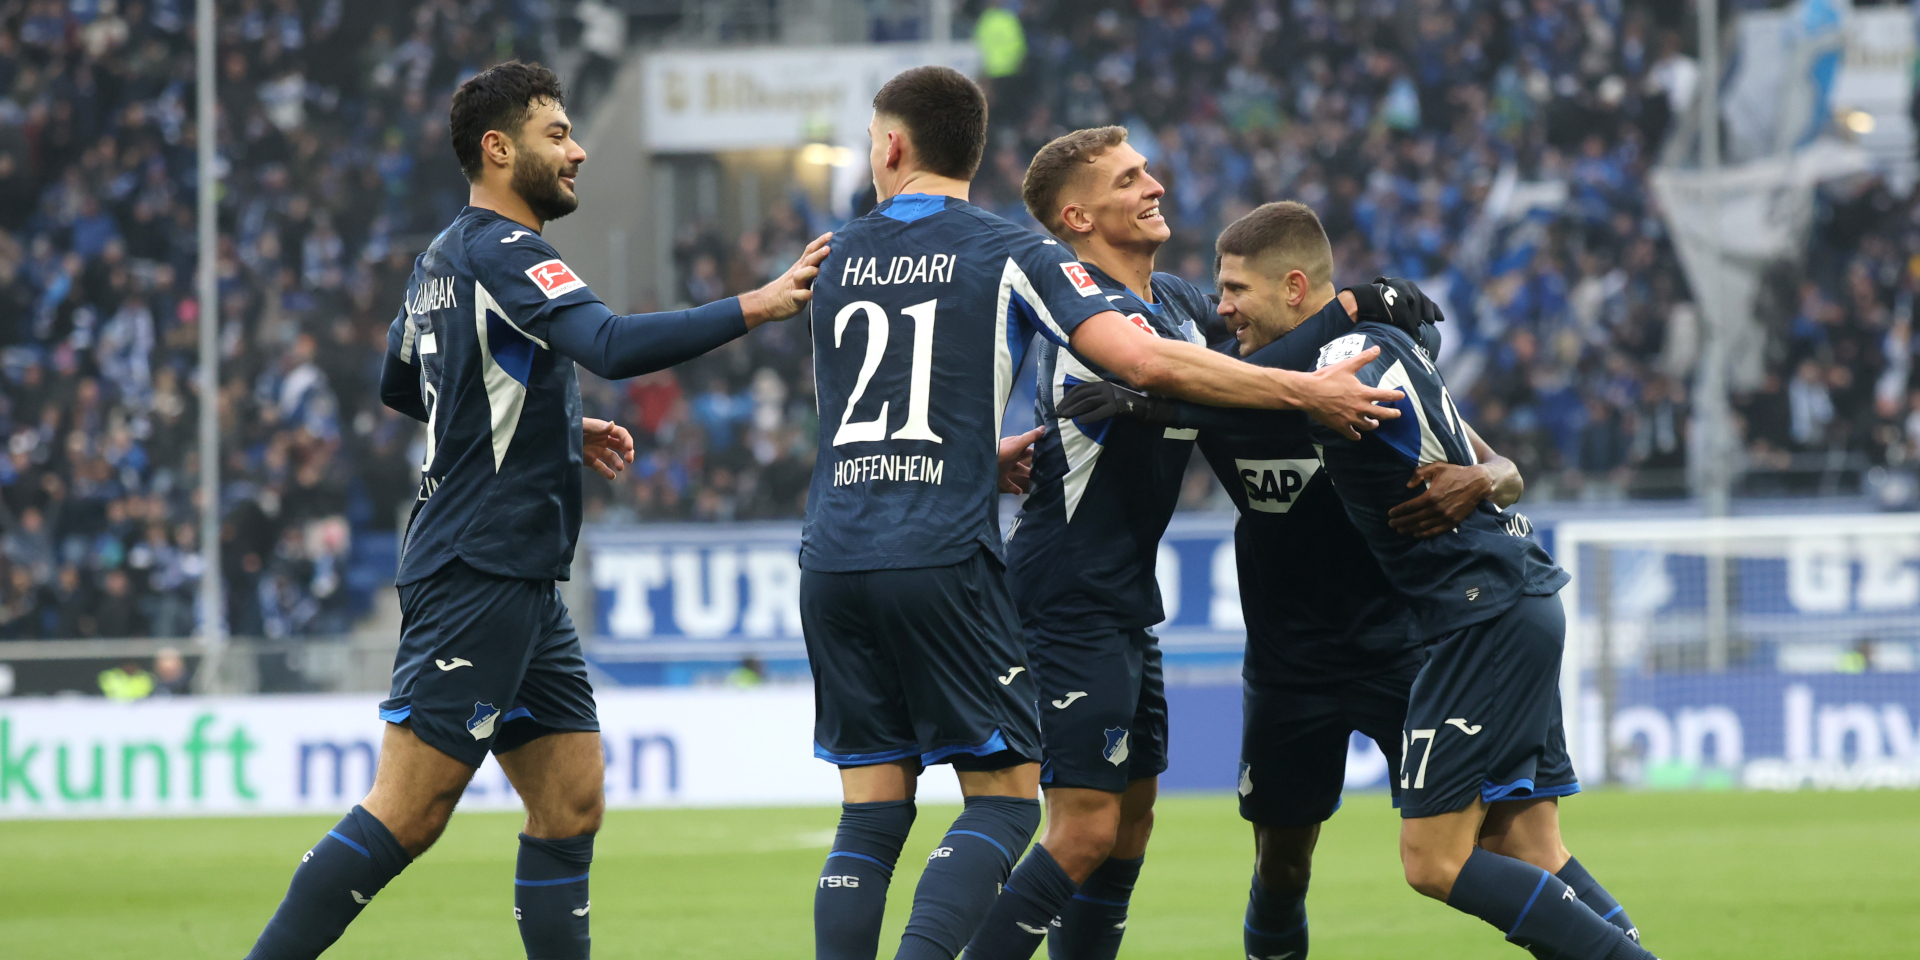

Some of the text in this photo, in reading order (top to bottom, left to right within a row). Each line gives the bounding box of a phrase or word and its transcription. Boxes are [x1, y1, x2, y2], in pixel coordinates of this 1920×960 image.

[841, 254, 957, 287] HAJDARI
[832, 298, 943, 447] 21
[833, 454, 944, 487] HOFFENHEIM
[1240, 468, 1303, 503] SAP
[0, 714, 258, 801] kunft
[819, 875, 860, 889] TSG
